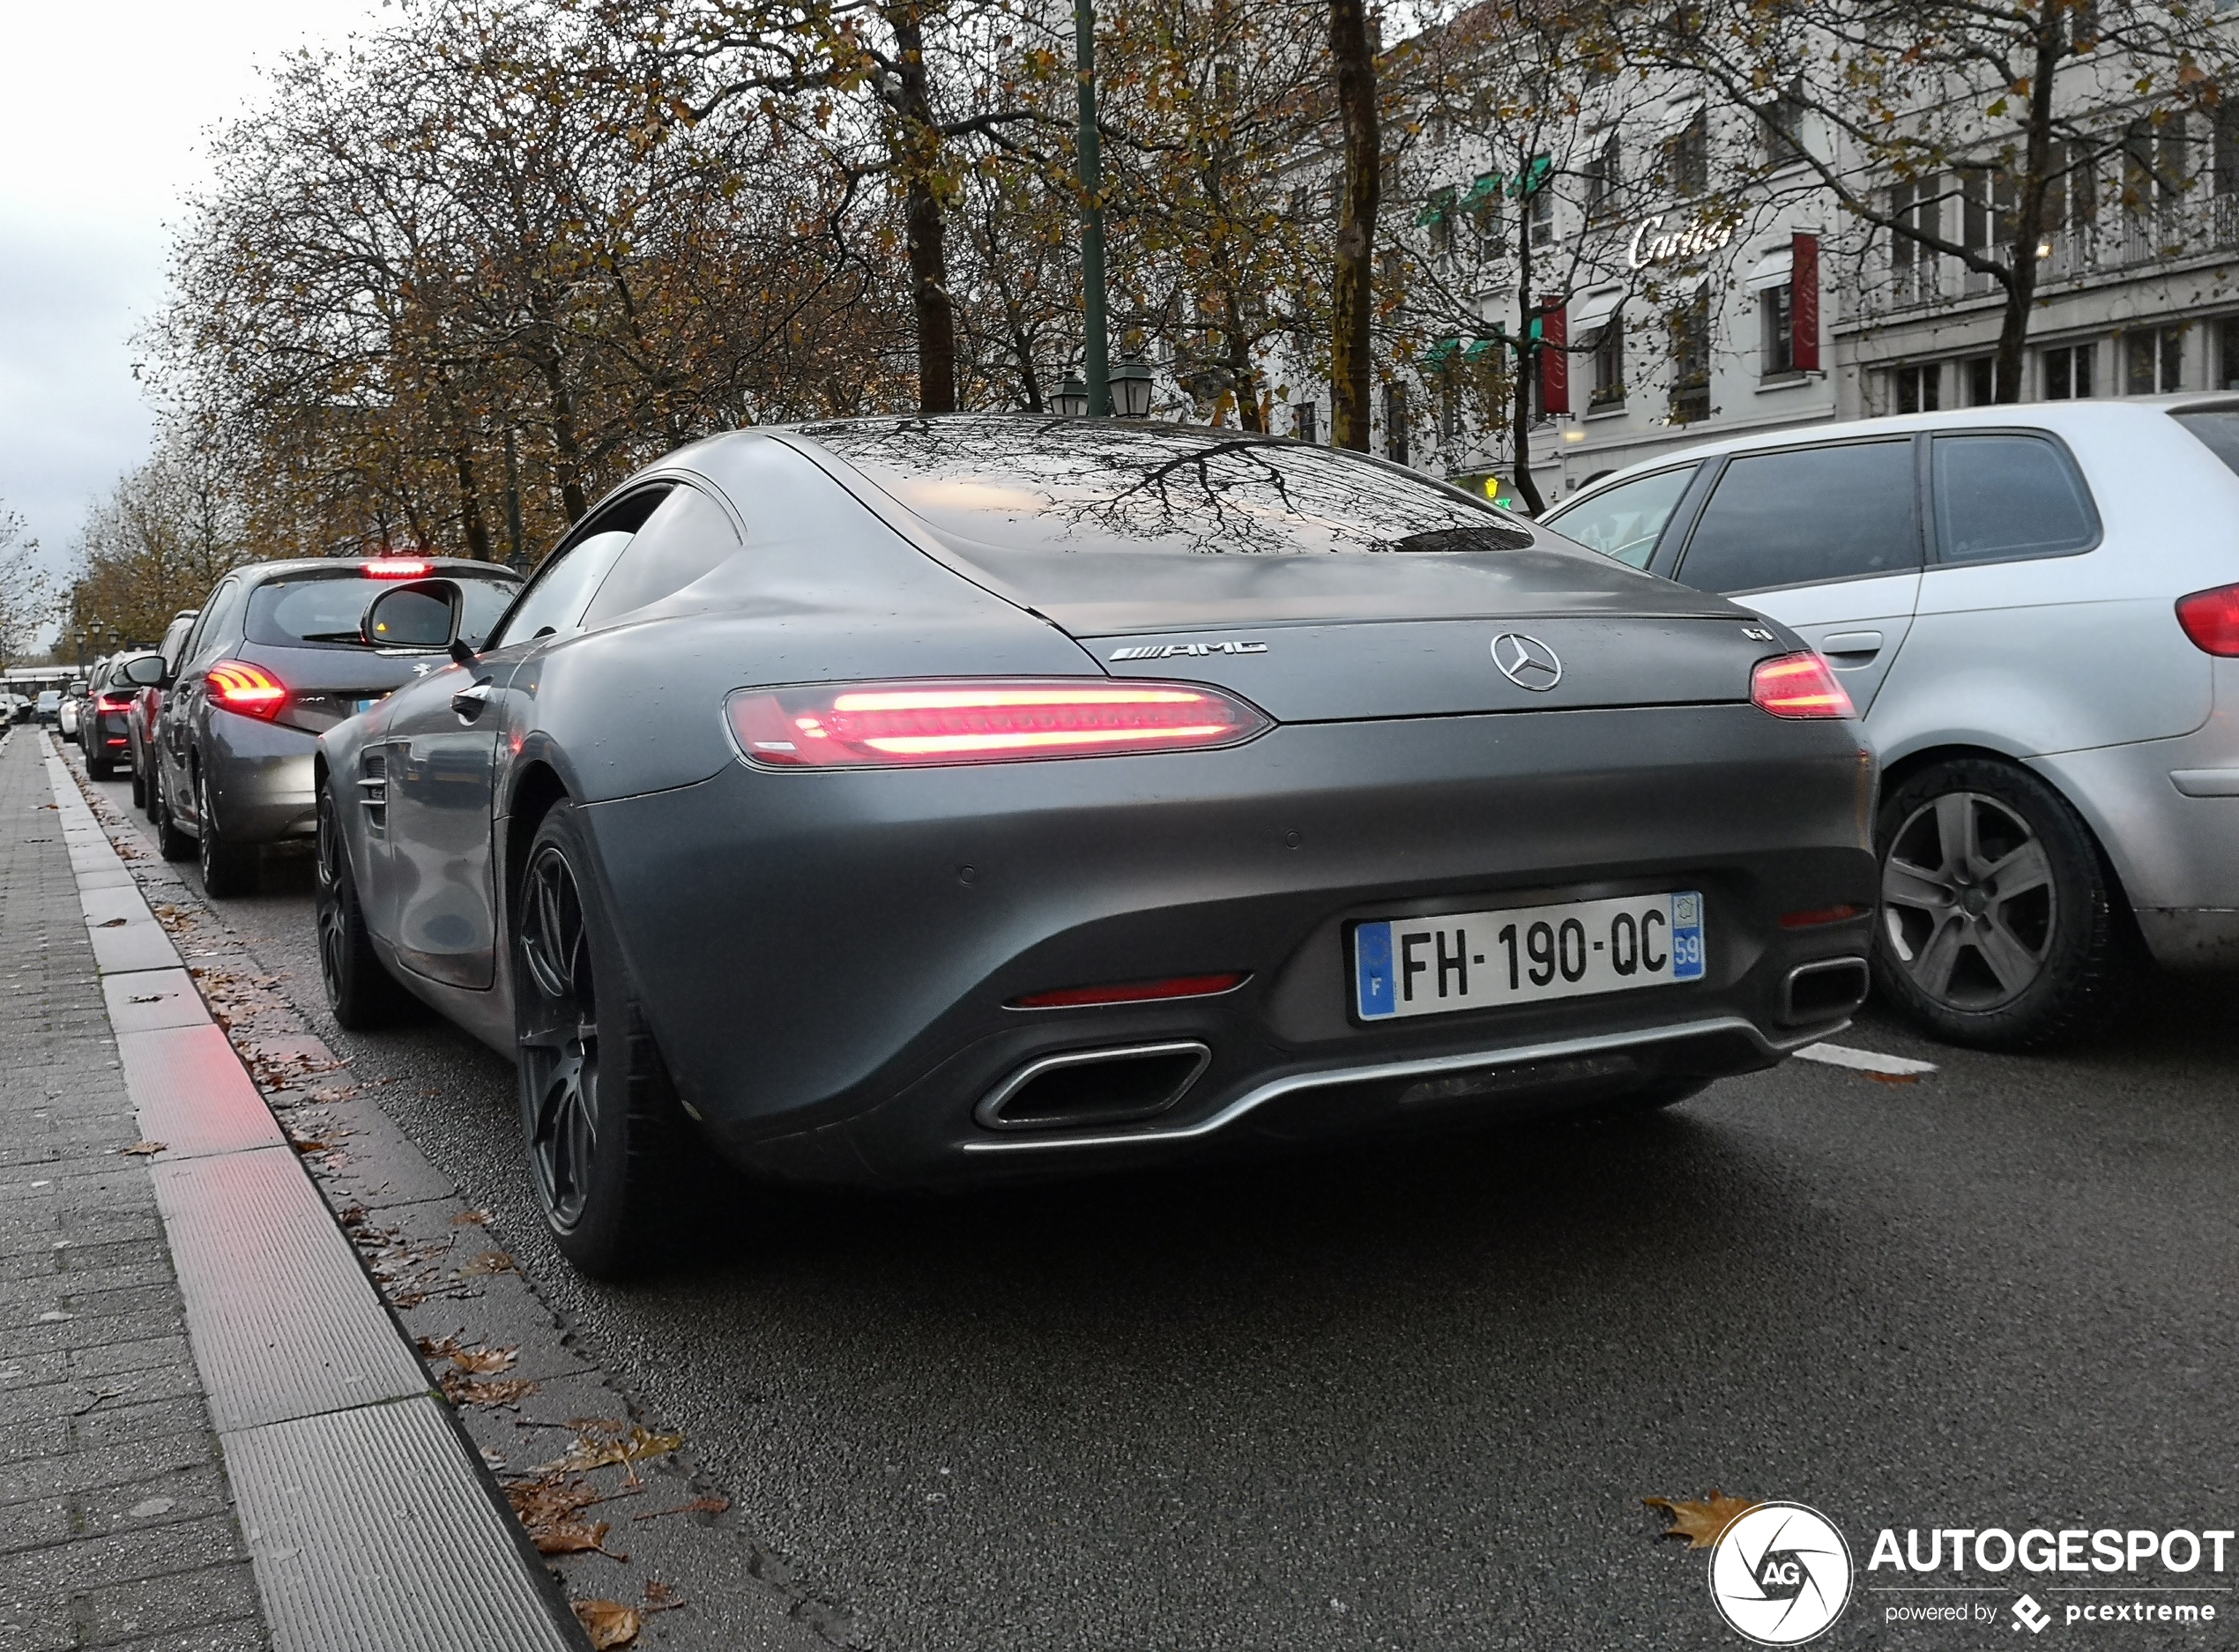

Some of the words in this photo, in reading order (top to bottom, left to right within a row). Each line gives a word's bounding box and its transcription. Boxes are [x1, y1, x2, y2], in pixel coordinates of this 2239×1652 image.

[1629, 215, 1744, 269] Cartier
[1160, 641, 1268, 659] AMG
[1402, 909, 1668, 1001] FH-190-QC
[1675, 935, 1700, 964] 59
[1371, 977, 1382, 996] F
